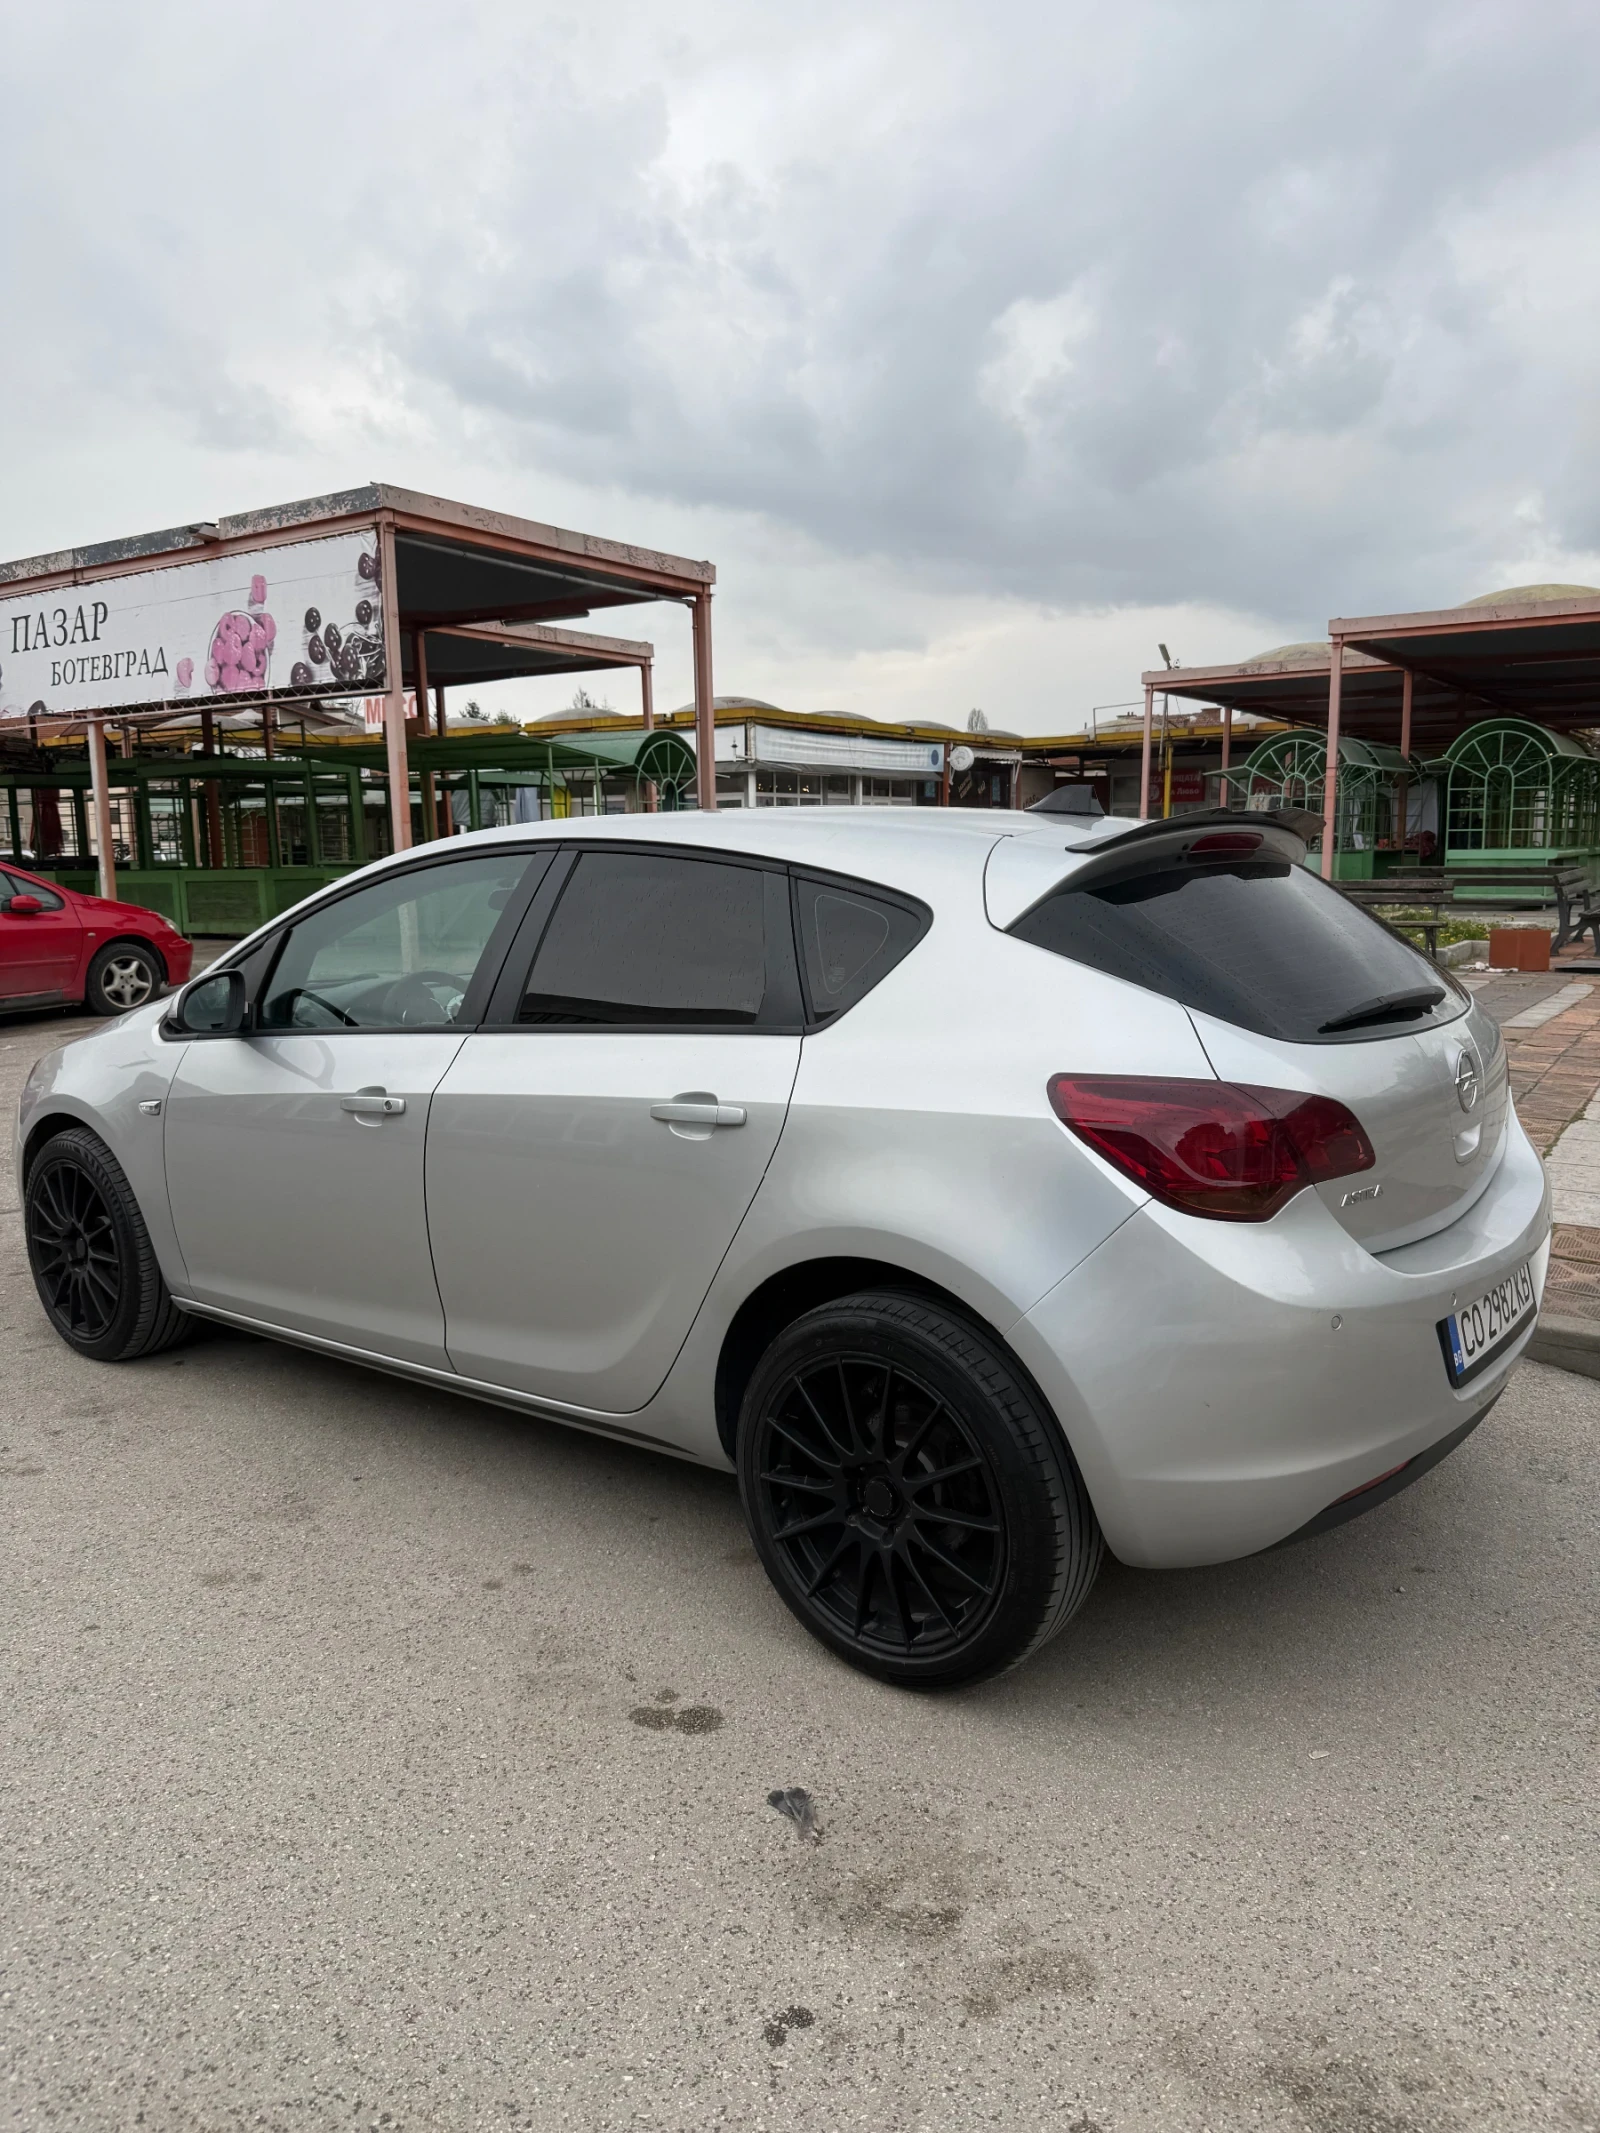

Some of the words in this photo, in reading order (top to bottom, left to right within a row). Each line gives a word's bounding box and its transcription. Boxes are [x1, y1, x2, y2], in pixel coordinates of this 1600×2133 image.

[11, 601, 108, 654] ПАЗАР
[50, 646, 169, 687] БОТЕВГРАД
[1340, 1184, 1384, 1207] ASTRA
[1483, 1276, 1518, 1340] 2982
[1453, 1349, 1463, 1367] BG
